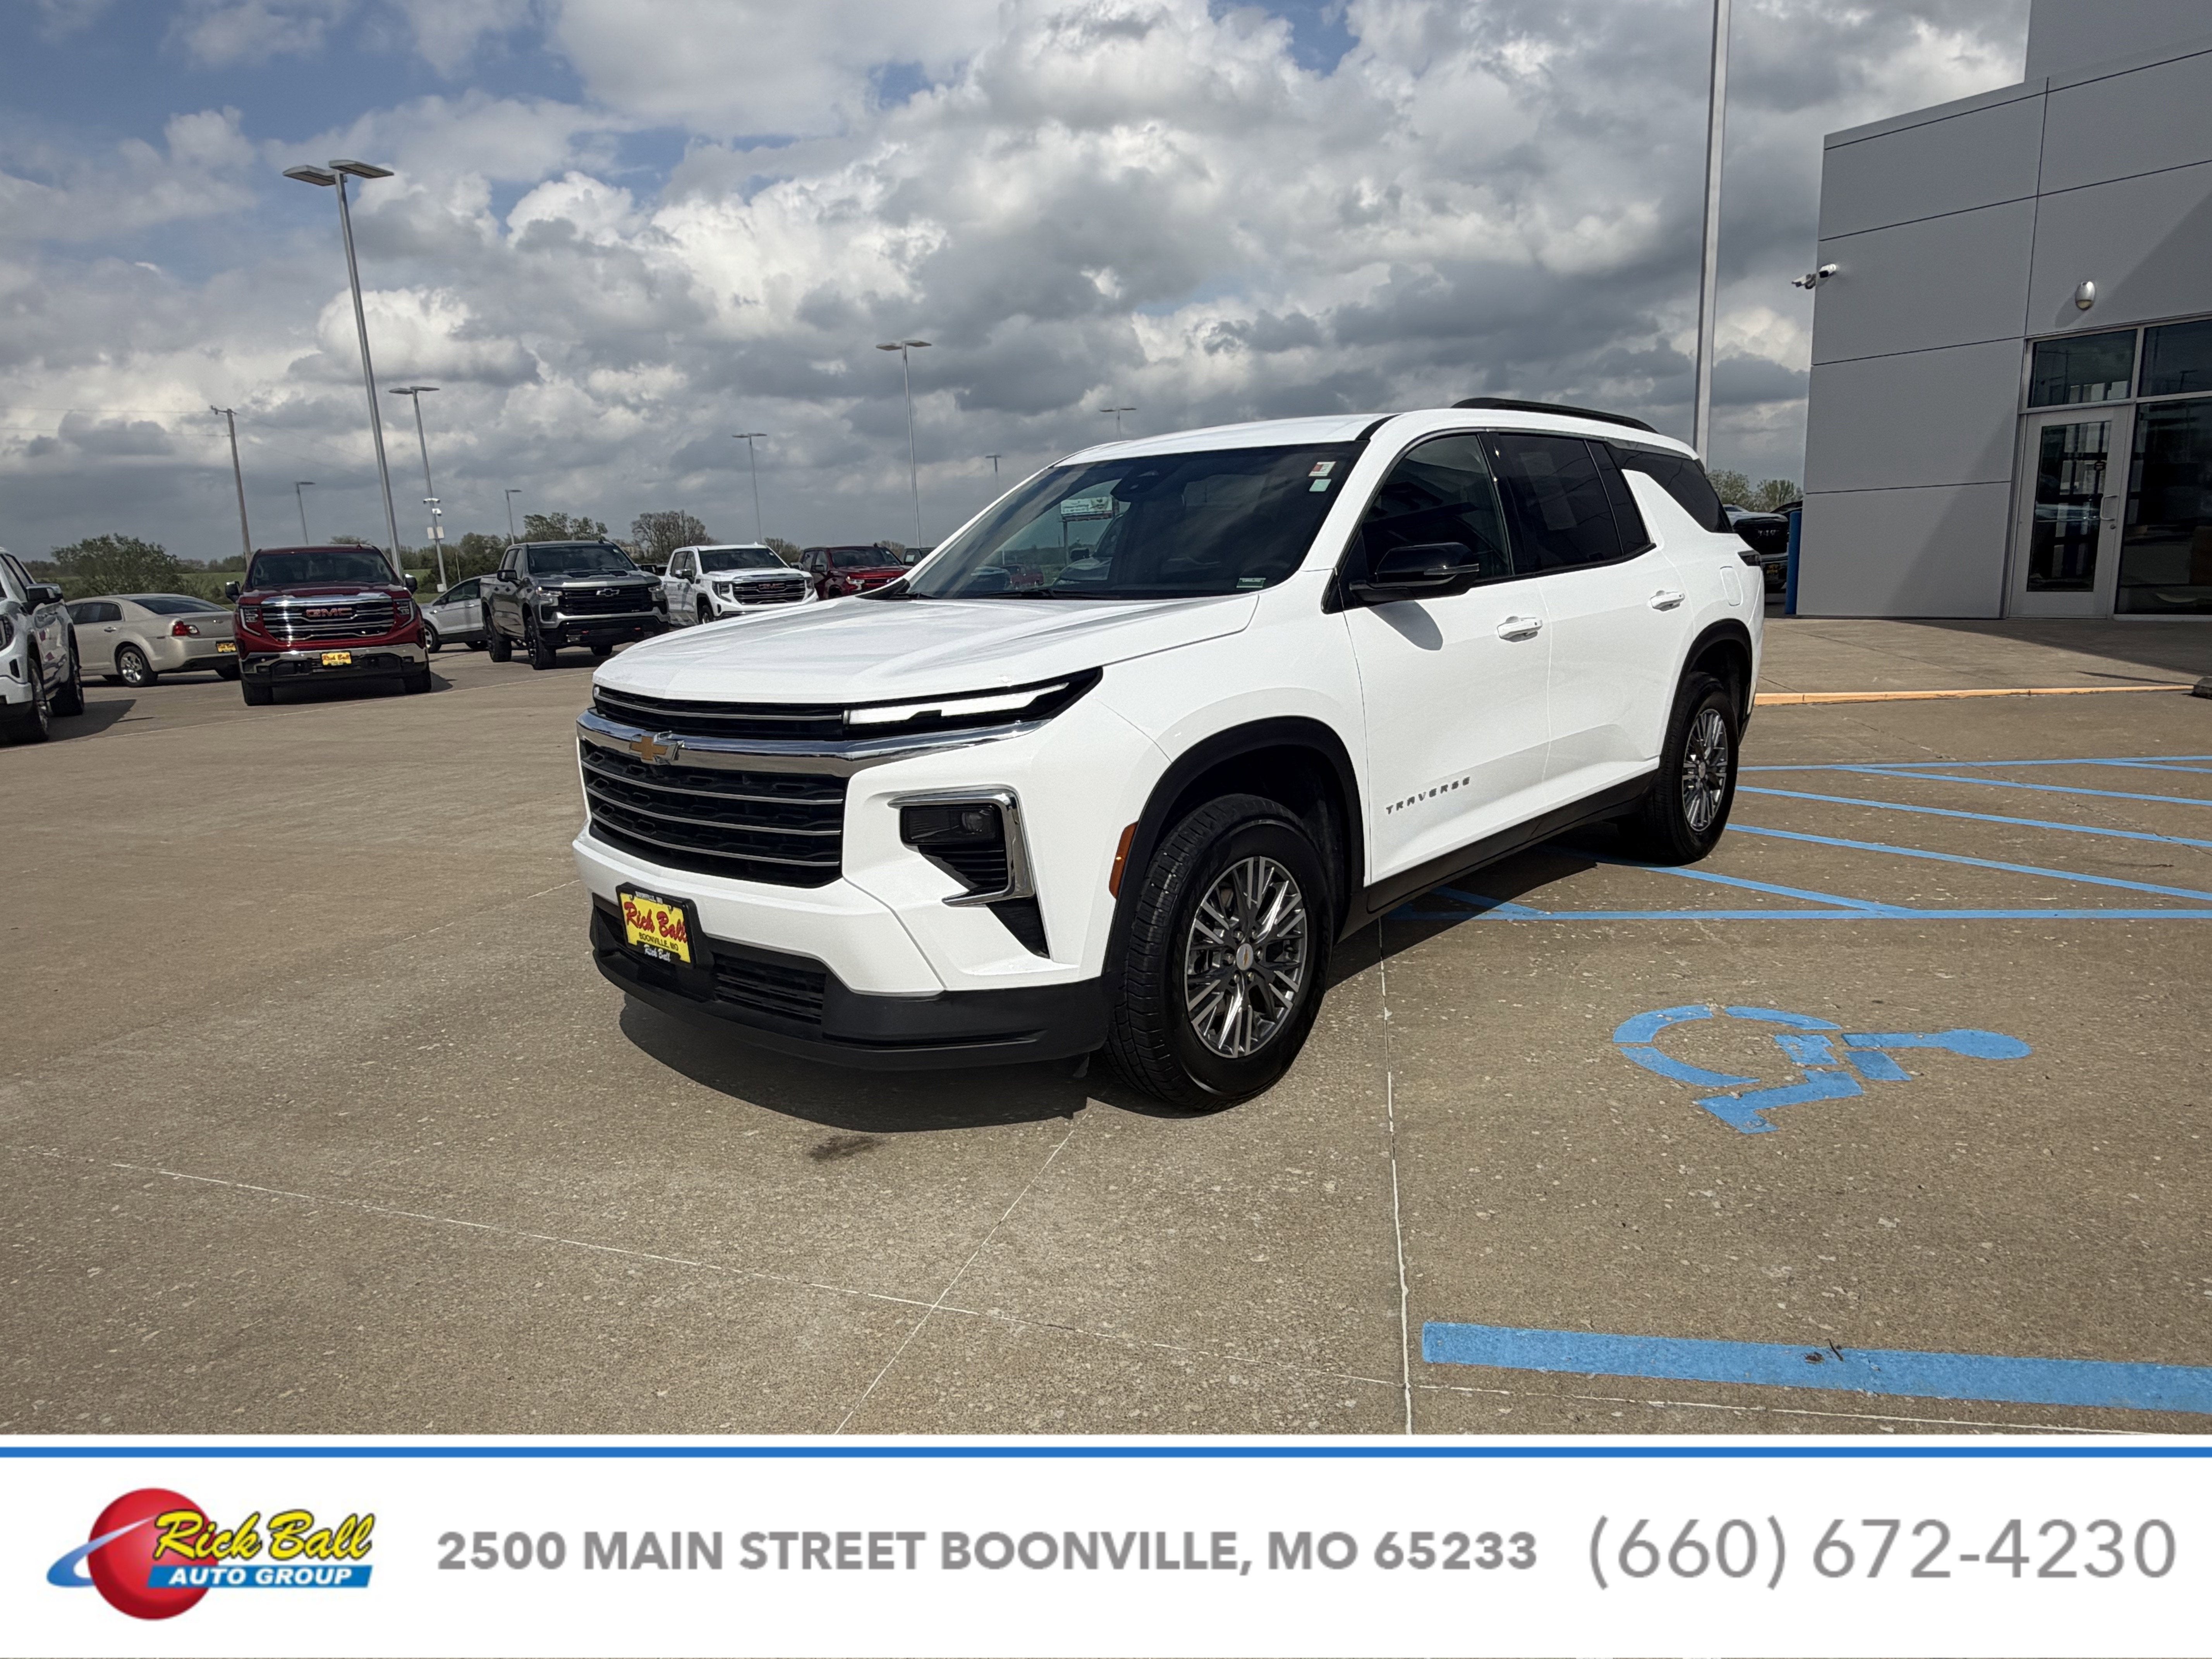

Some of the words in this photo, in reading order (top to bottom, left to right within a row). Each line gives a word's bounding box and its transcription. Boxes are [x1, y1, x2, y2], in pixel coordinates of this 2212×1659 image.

[306, 608, 352, 617] GMC
[1386, 776, 1470, 815] TRAVERSE
[624, 902, 655, 933] Rick
[656, 911, 687, 943] Ball
